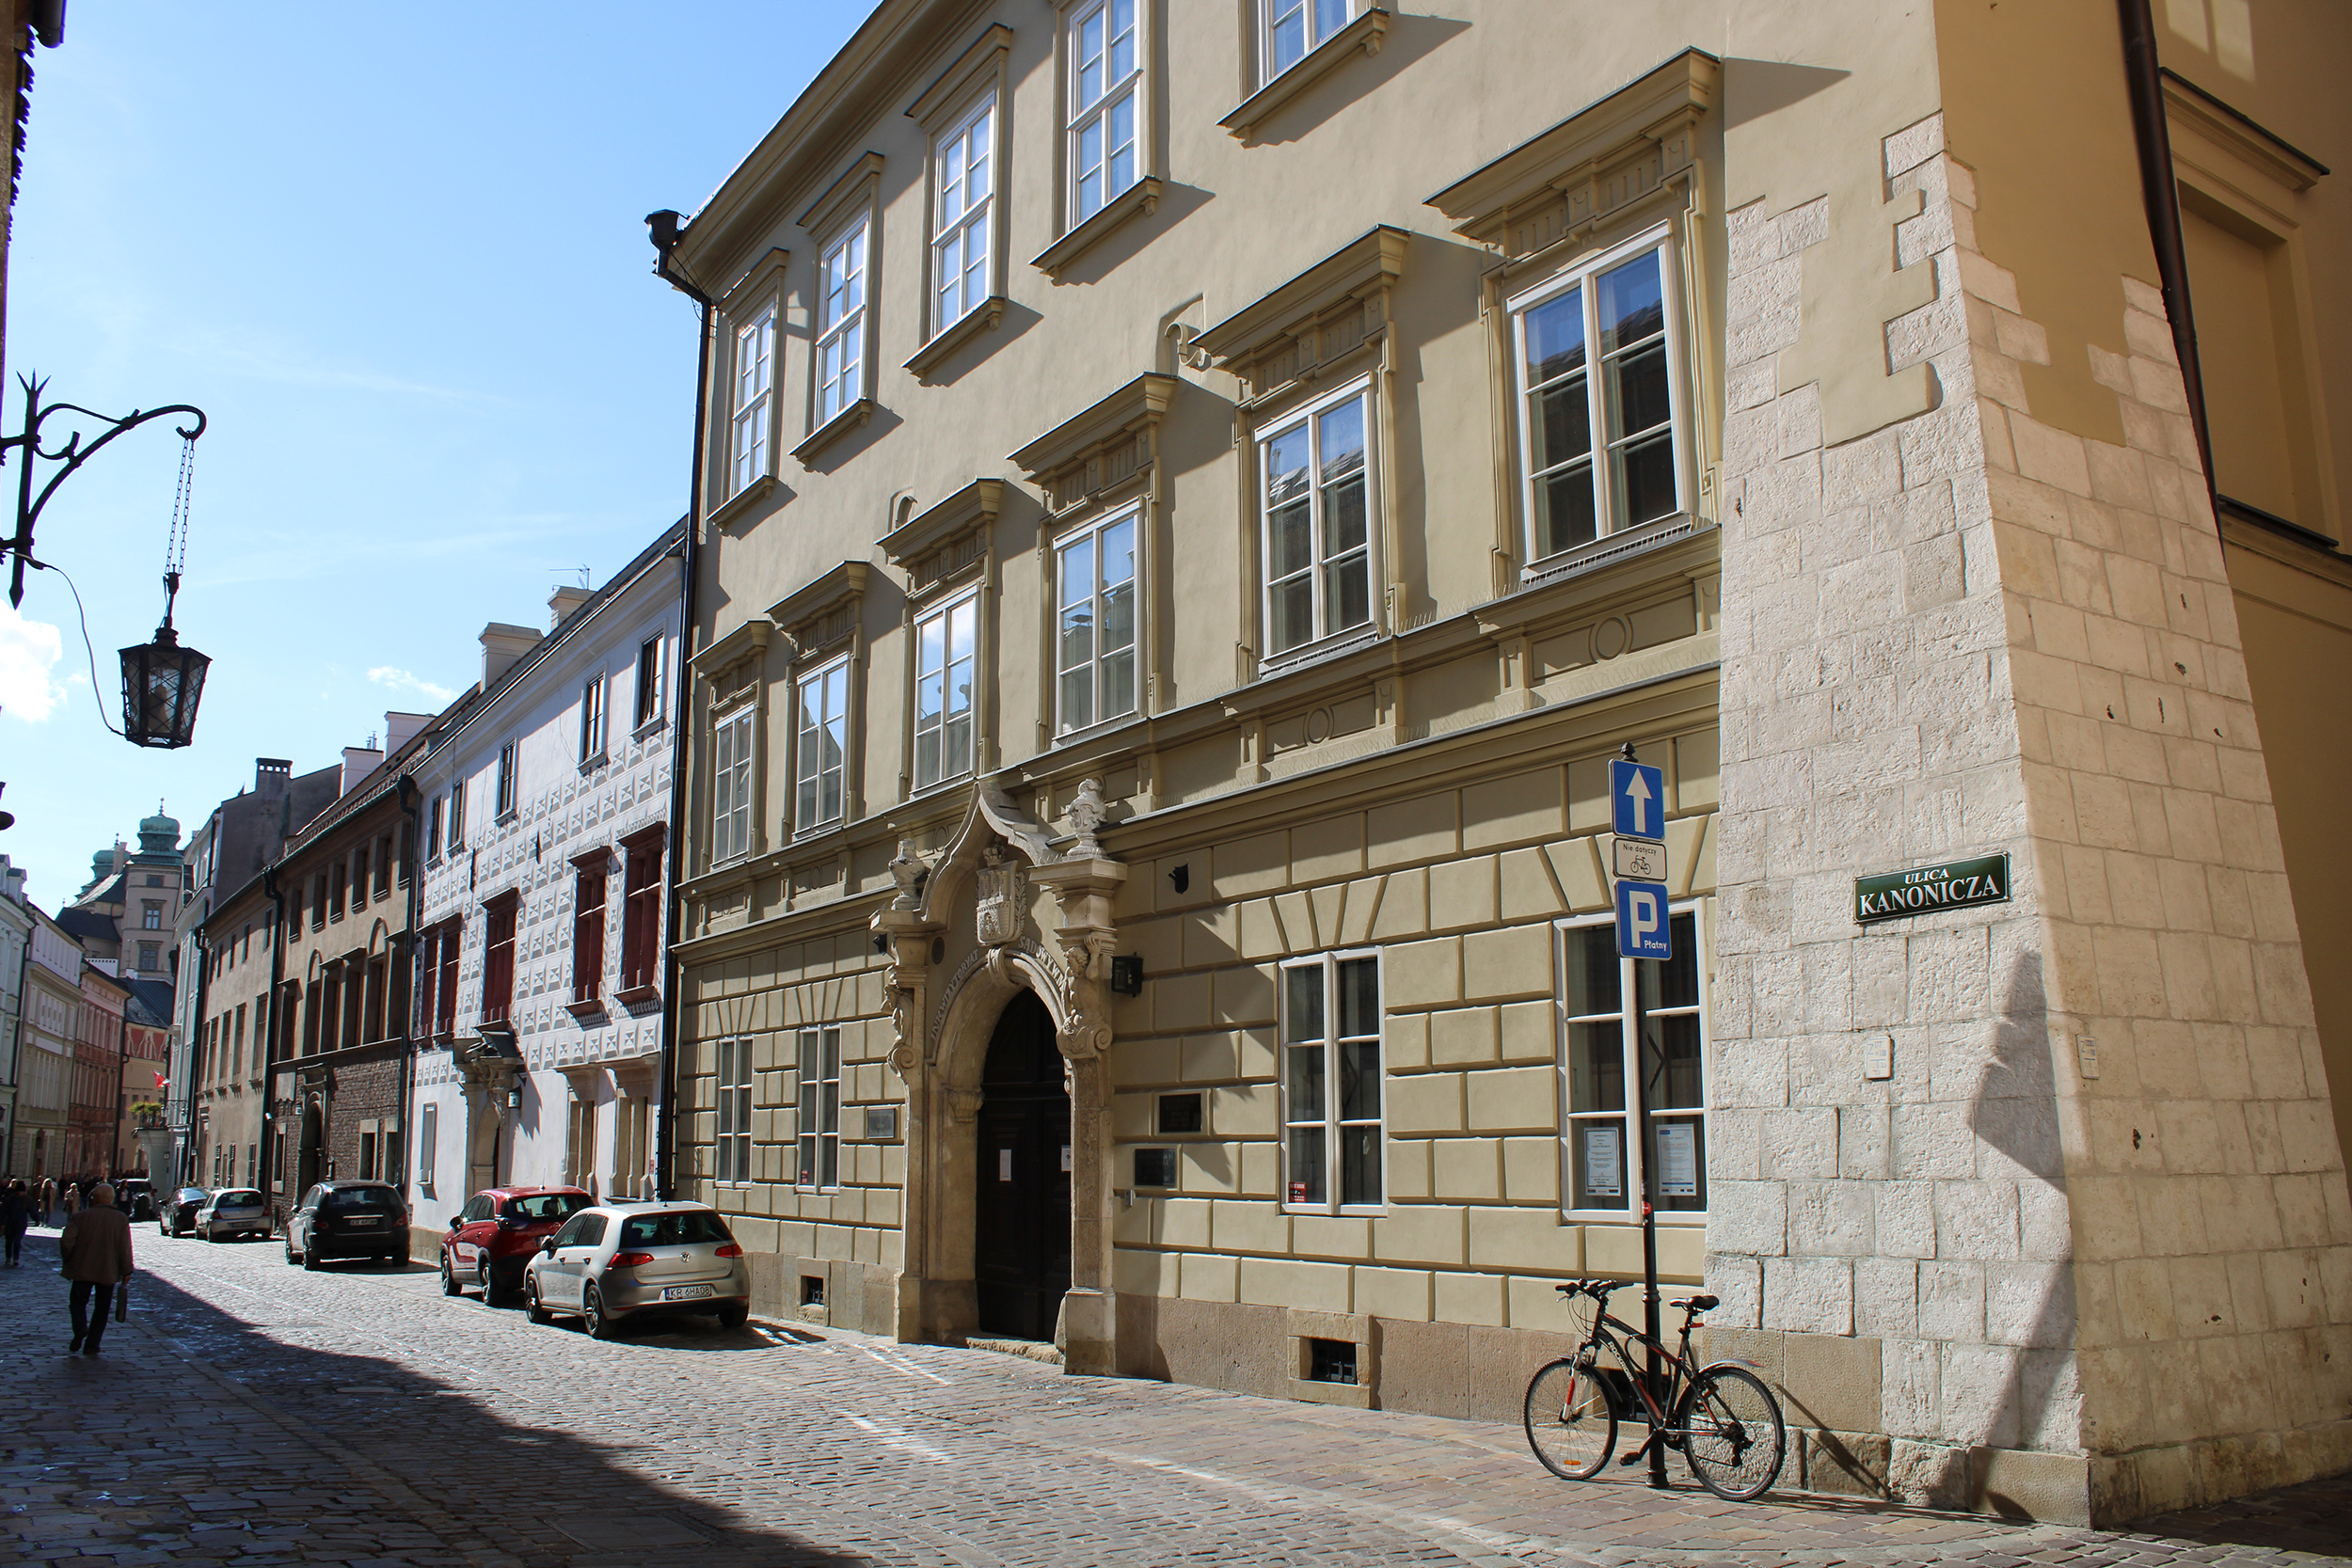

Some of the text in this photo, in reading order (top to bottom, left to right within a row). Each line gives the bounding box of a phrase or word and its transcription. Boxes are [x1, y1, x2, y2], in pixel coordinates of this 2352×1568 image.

[1623, 843, 1657, 856] Nie dotyczy
[1904, 868, 1949, 885] ULICA
[1859, 874, 2000, 916] KANONICZA
[1629, 890, 1659, 948] P
[671, 1288, 683, 1298] KR
[1607, 1340, 1635, 1382] ROCKRIDER
